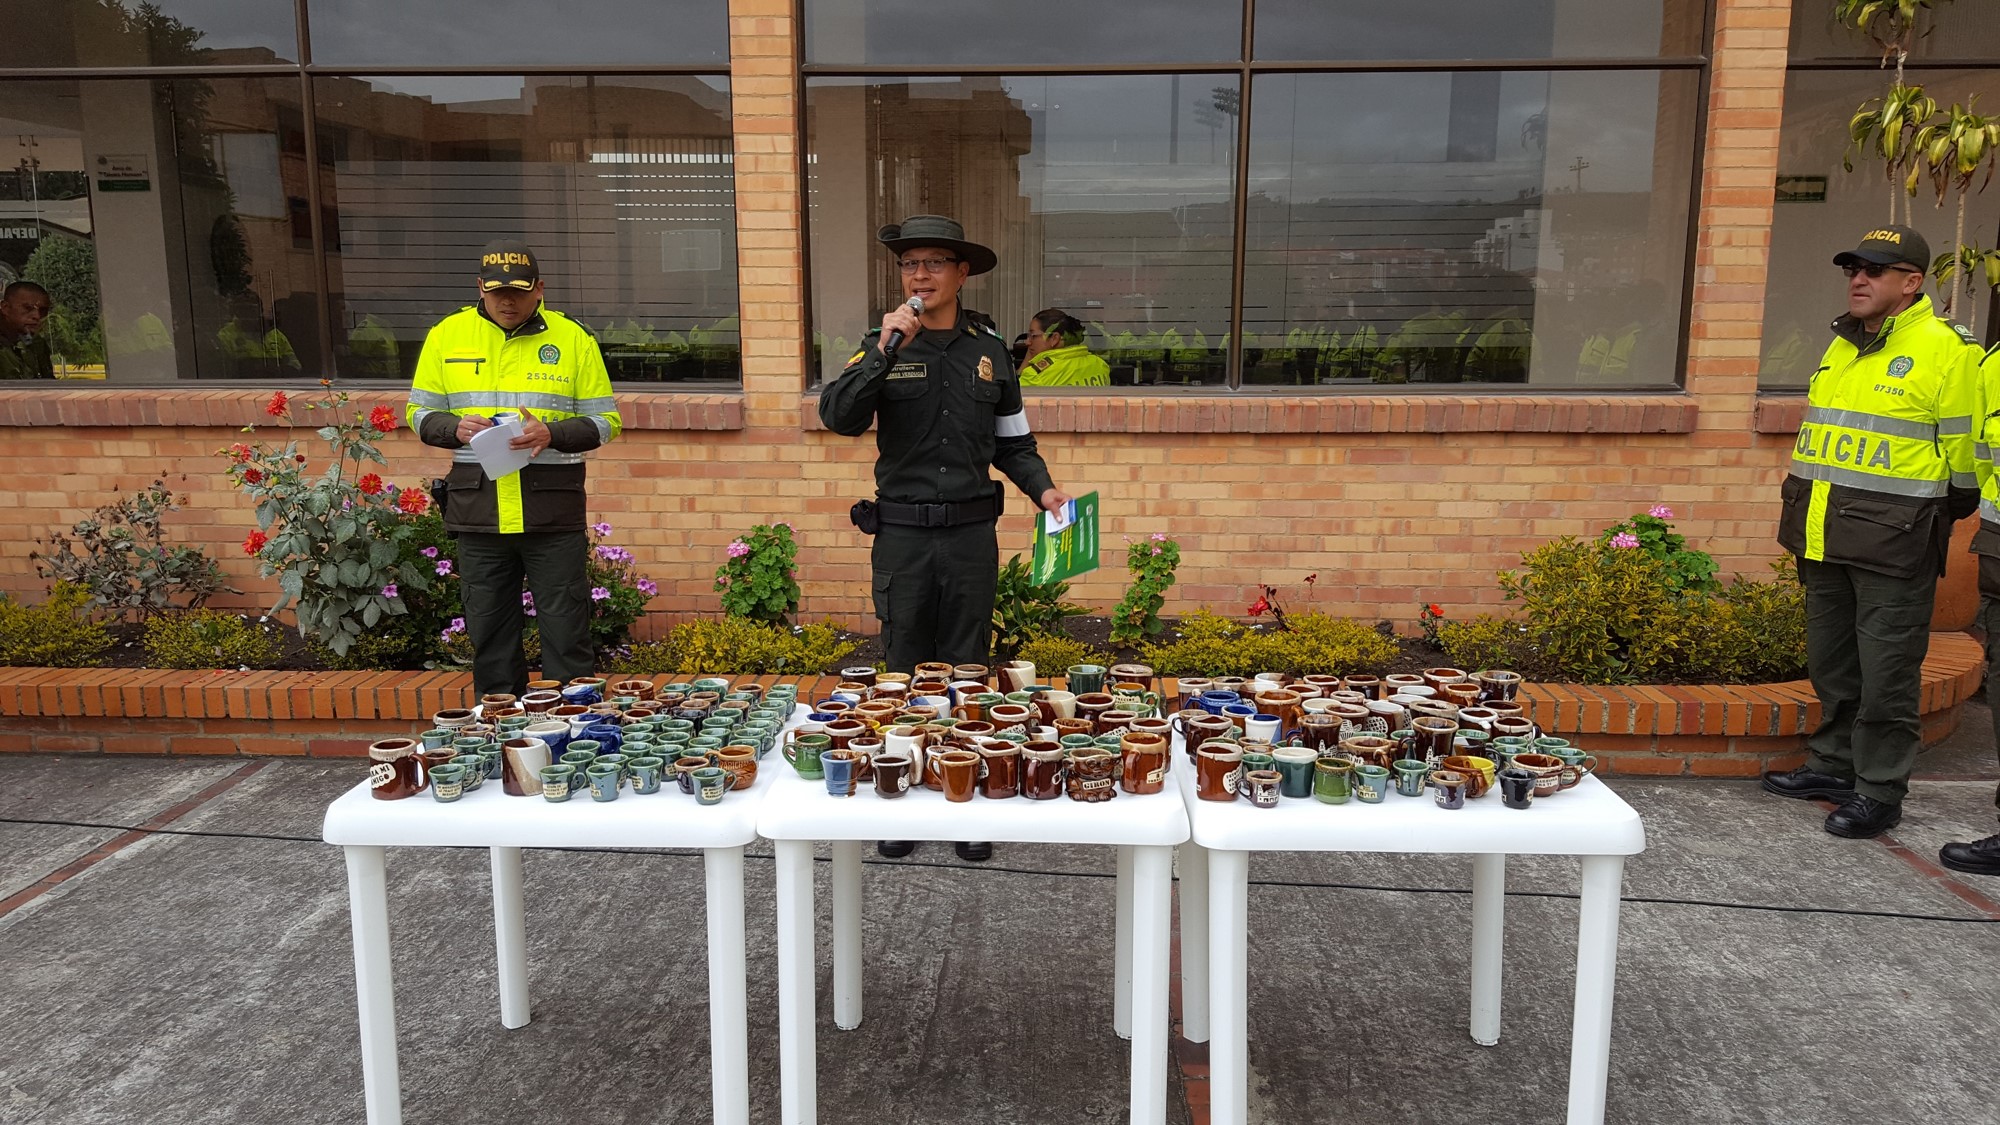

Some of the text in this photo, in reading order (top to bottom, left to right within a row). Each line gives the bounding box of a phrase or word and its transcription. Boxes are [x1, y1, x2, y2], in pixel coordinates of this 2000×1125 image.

[482, 252, 531, 267] POLICIA
[526, 372, 570, 384] 253444
[1873, 383, 1905, 397] 87350
[1796, 427, 1892, 470] OLICIA
[1083, 779, 1111, 789] GIRON
